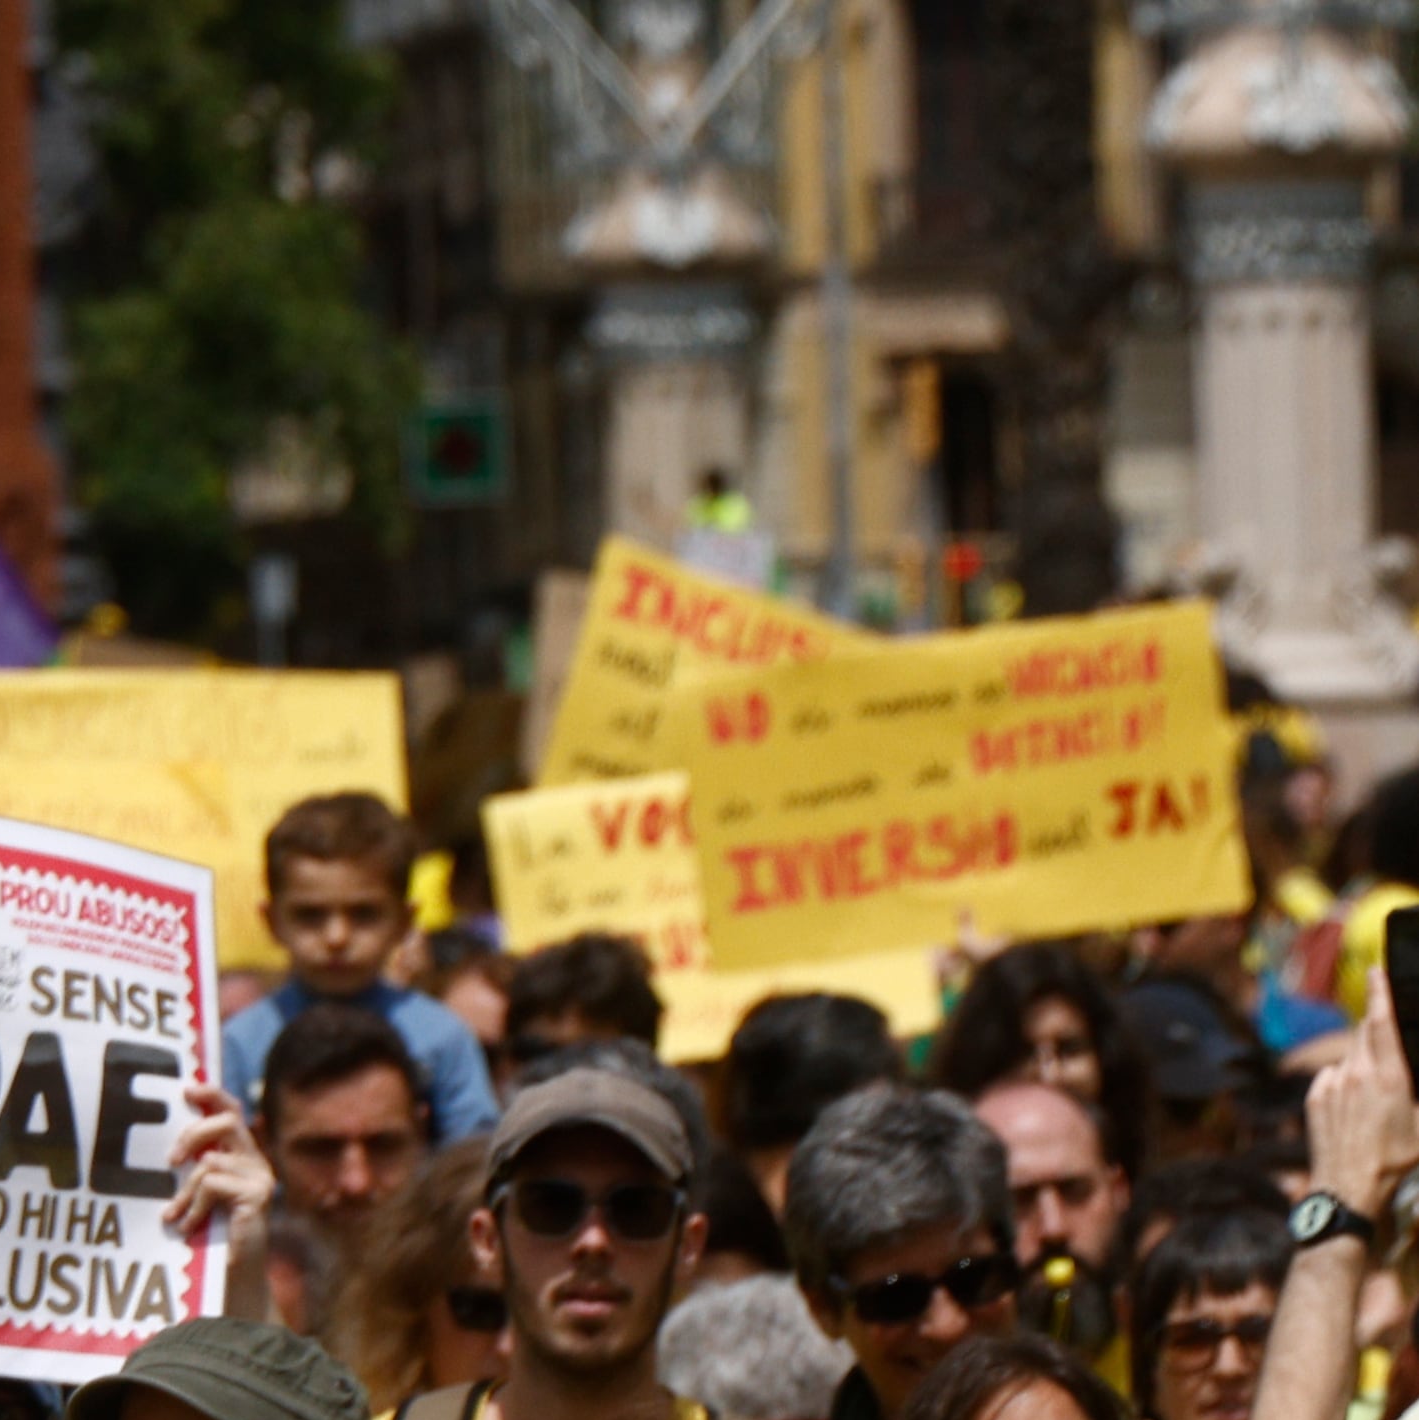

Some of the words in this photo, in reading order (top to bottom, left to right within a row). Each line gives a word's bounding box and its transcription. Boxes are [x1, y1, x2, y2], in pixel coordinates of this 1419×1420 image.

[0, 880, 70, 918] PROU
[78, 896, 180, 944] ABUSOS!
[29, 965, 181, 1039] SENSE
[18, 1192, 57, 1242] HI
[67, 1196, 124, 1248] HA
